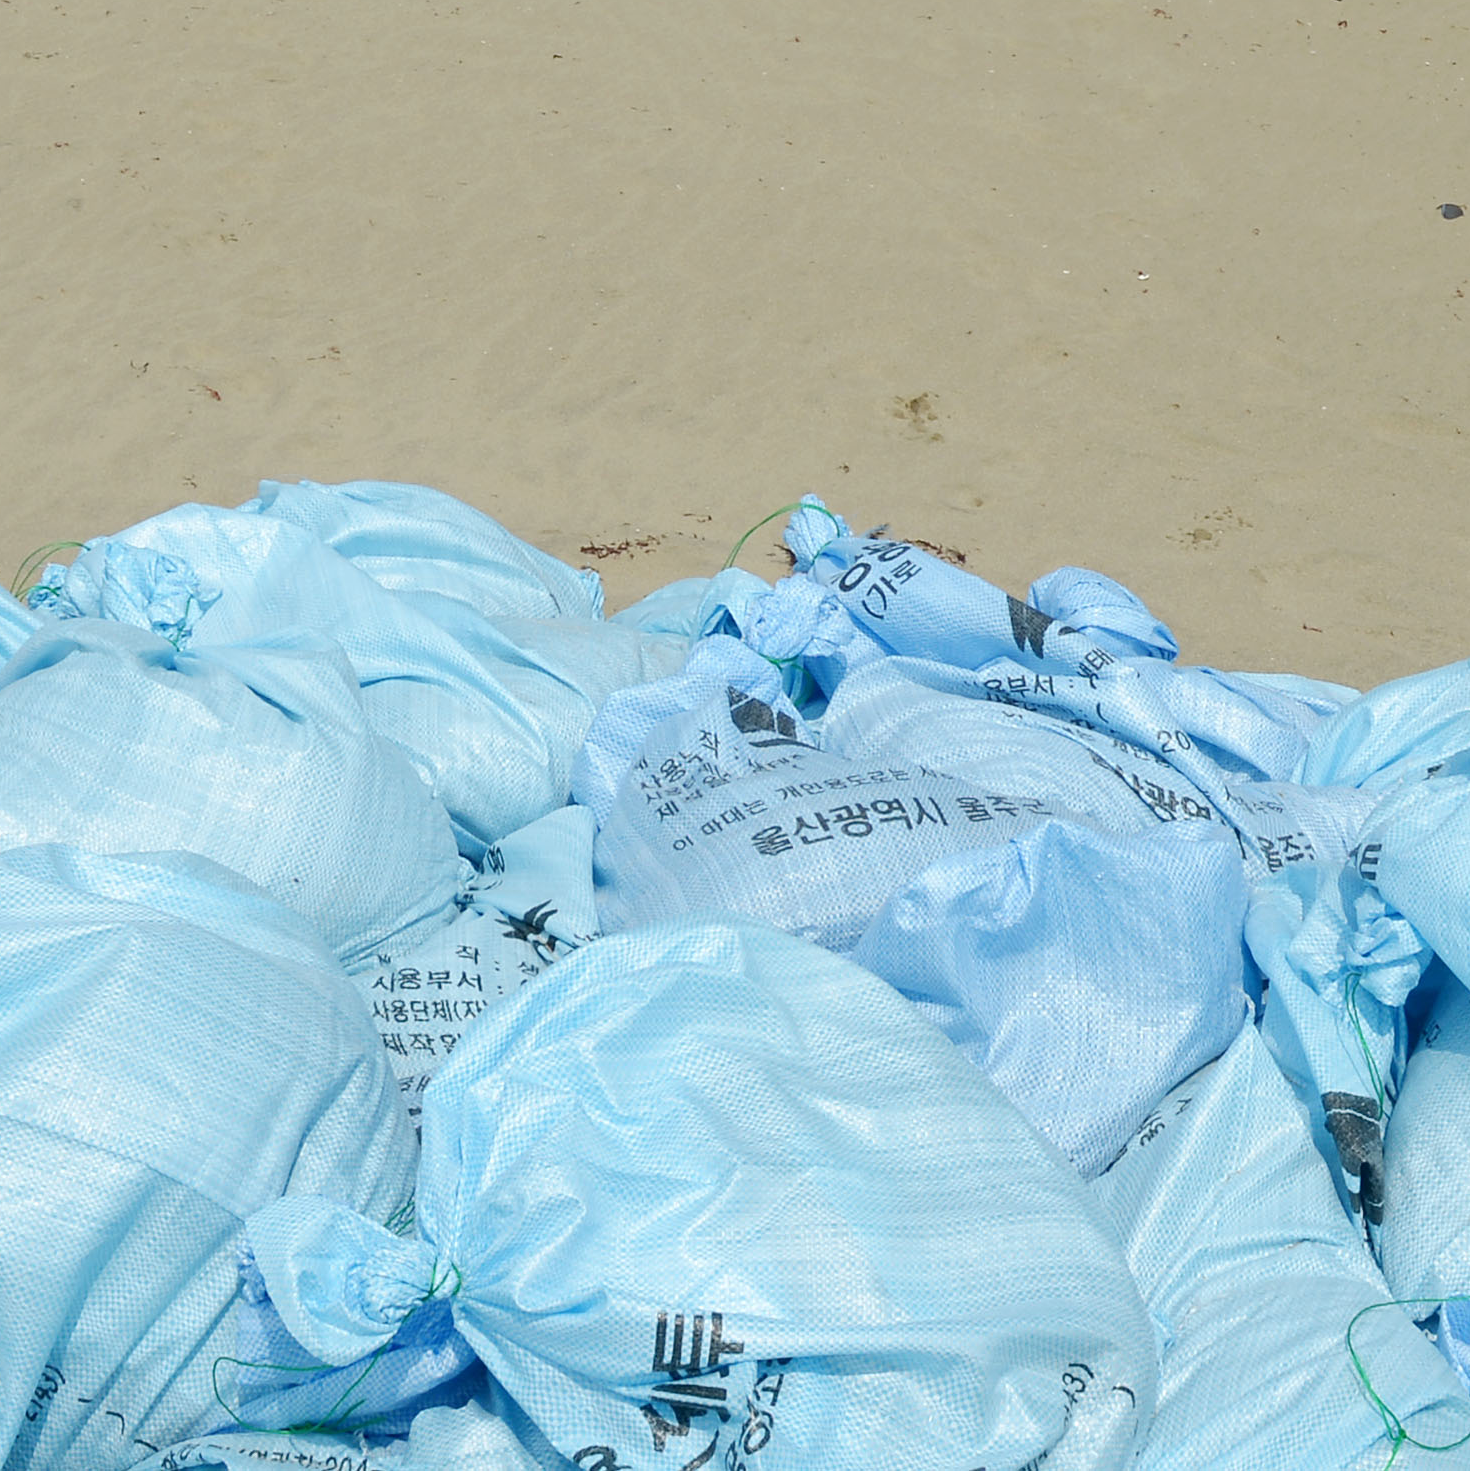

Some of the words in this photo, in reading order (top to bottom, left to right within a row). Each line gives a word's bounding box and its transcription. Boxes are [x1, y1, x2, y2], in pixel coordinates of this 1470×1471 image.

[1157, 729, 1192, 754] 20
[672, 834, 695, 852] 이
[700, 798, 769, 837] 마대는
[751, 796, 949, 857] 울산광역시
[371, 967, 484, 994] 사용부서
